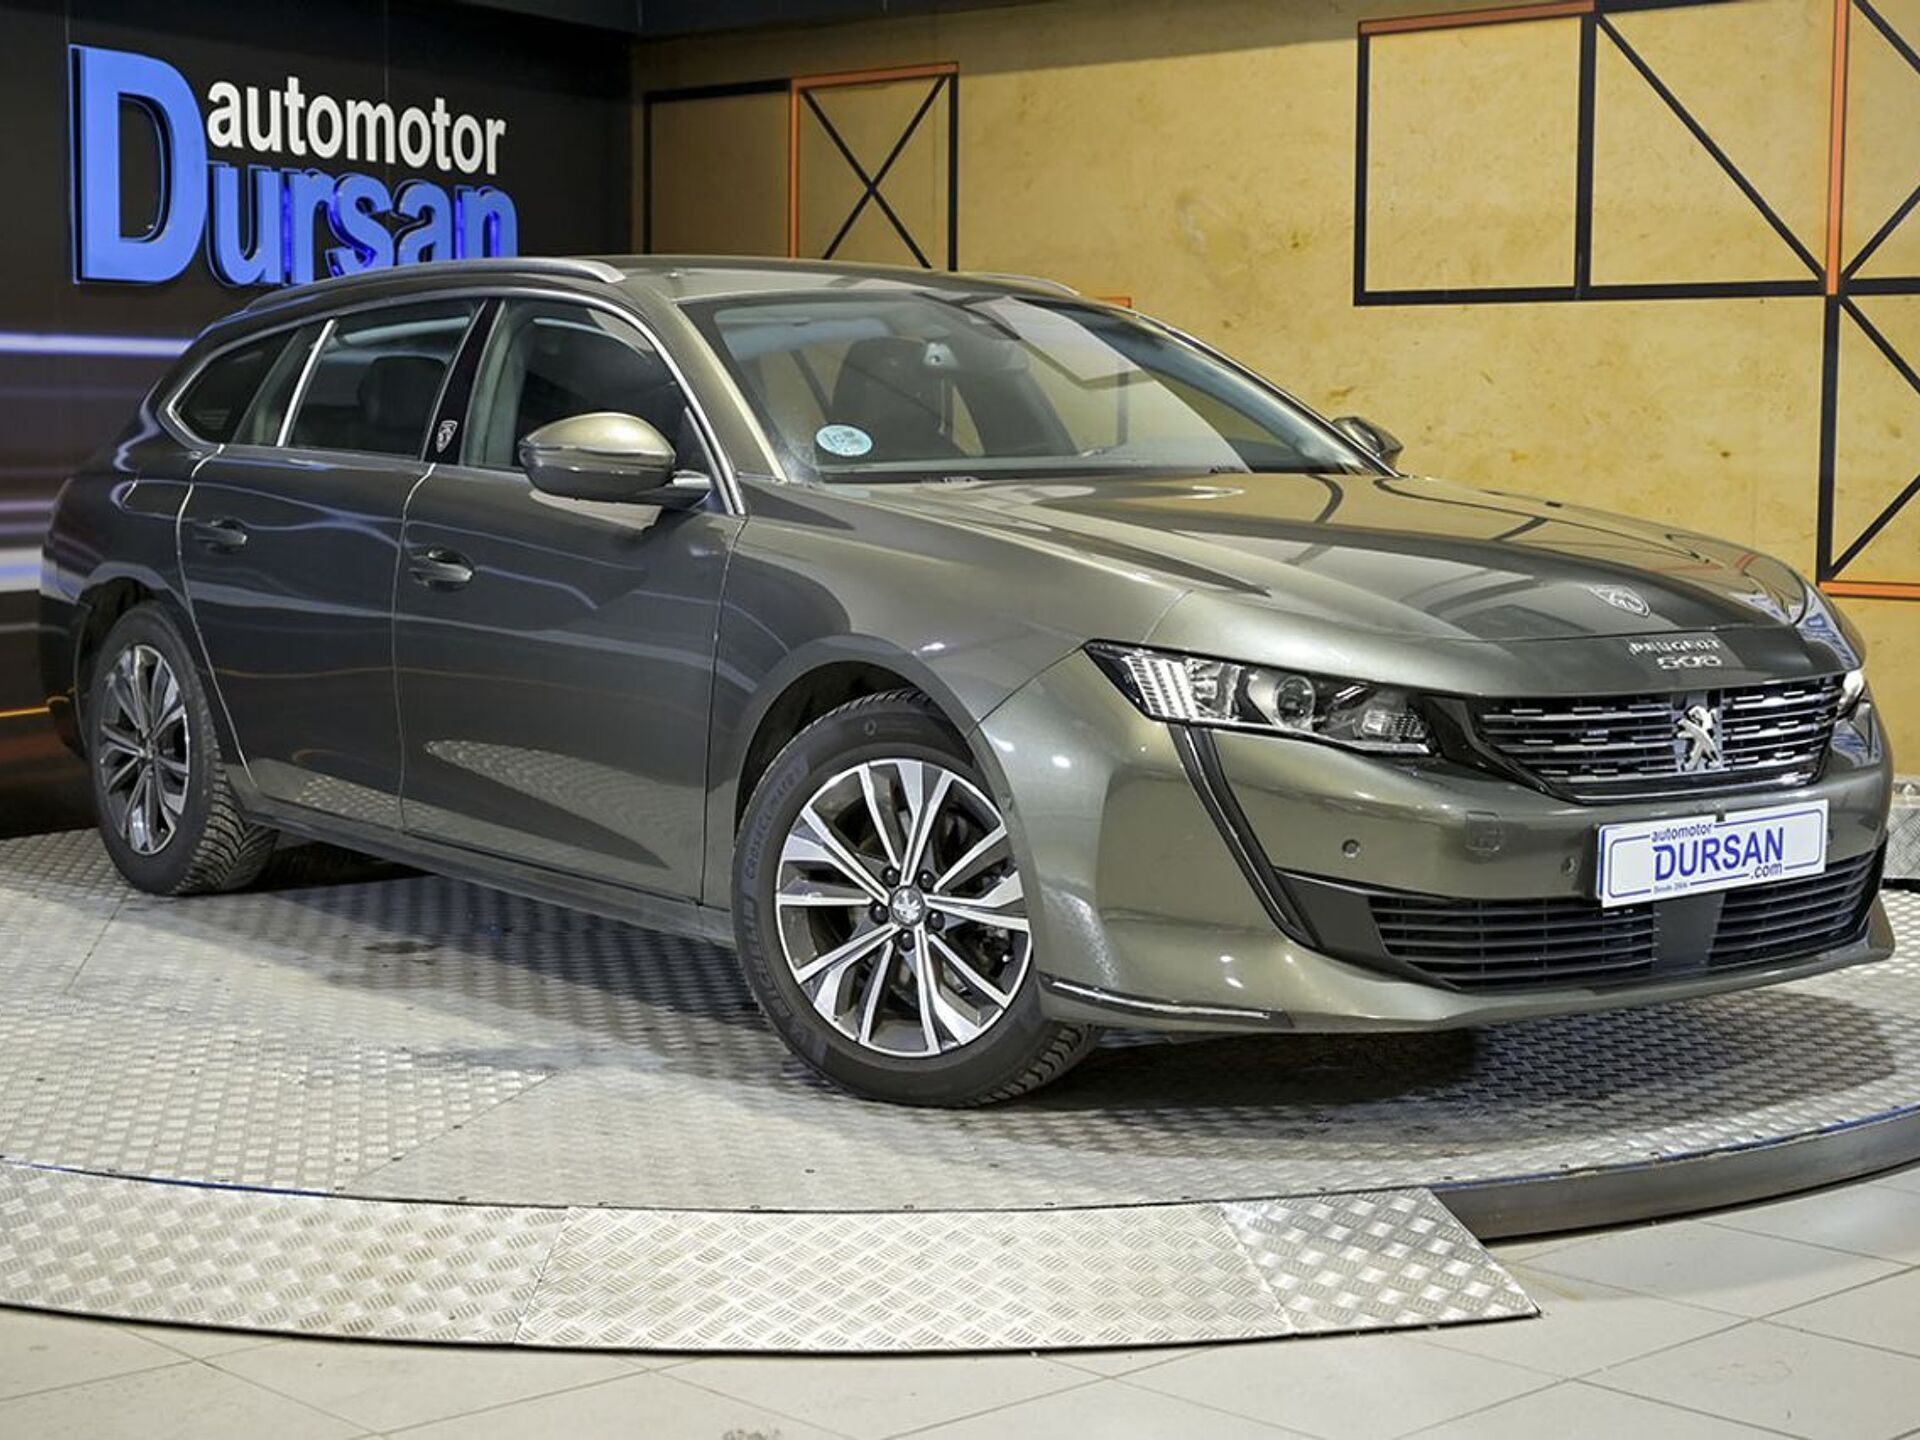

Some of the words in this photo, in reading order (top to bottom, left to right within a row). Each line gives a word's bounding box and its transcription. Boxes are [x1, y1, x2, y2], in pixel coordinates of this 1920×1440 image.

[206, 76, 506, 176] automotor
[69, 44, 518, 286] Dursan
[1656, 654, 1723, 669] 508
[1651, 822, 1713, 843] automotor
[1652, 827, 1785, 881] DURSAN
[1750, 862, 1784, 880] .com
